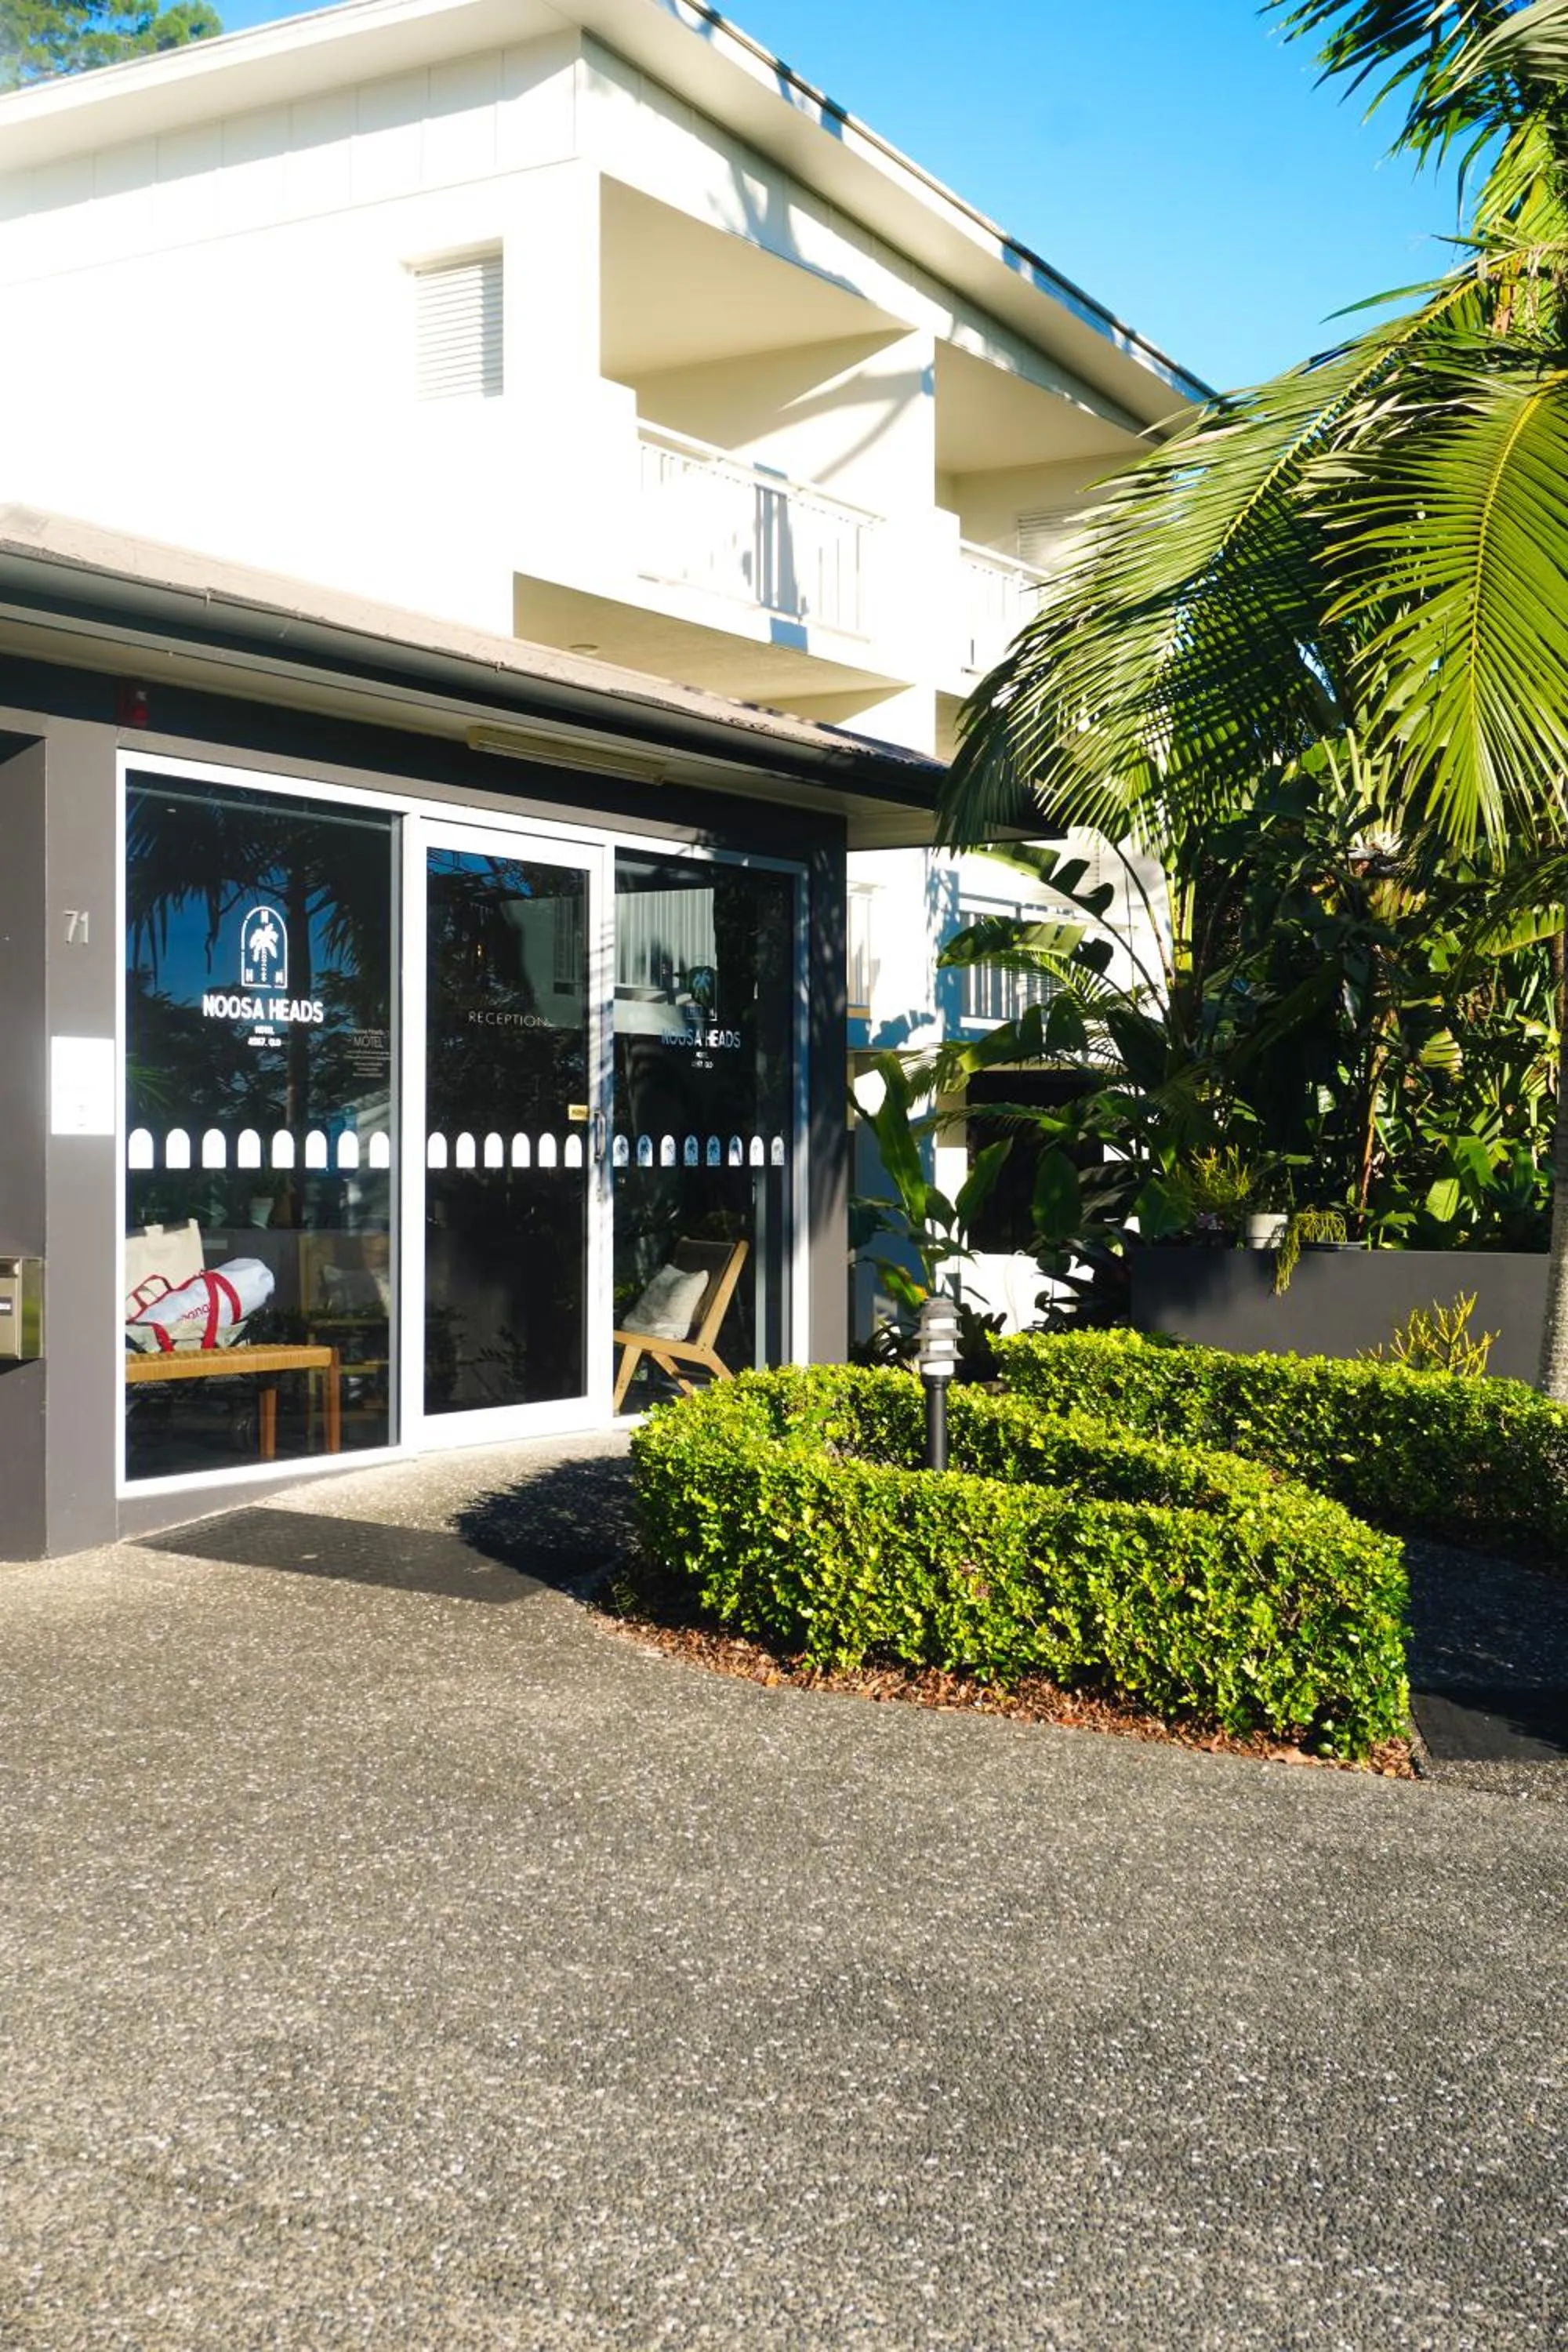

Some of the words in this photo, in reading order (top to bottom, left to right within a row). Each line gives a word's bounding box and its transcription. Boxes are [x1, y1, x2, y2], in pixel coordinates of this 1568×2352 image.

[63, 910, 89, 944] 71
[203, 994, 264, 1019] NOOSA
[269, 998, 324, 1023] HEADS
[468, 1010, 548, 1028] RECEPTION
[705, 1029, 741, 1049] HEADS
